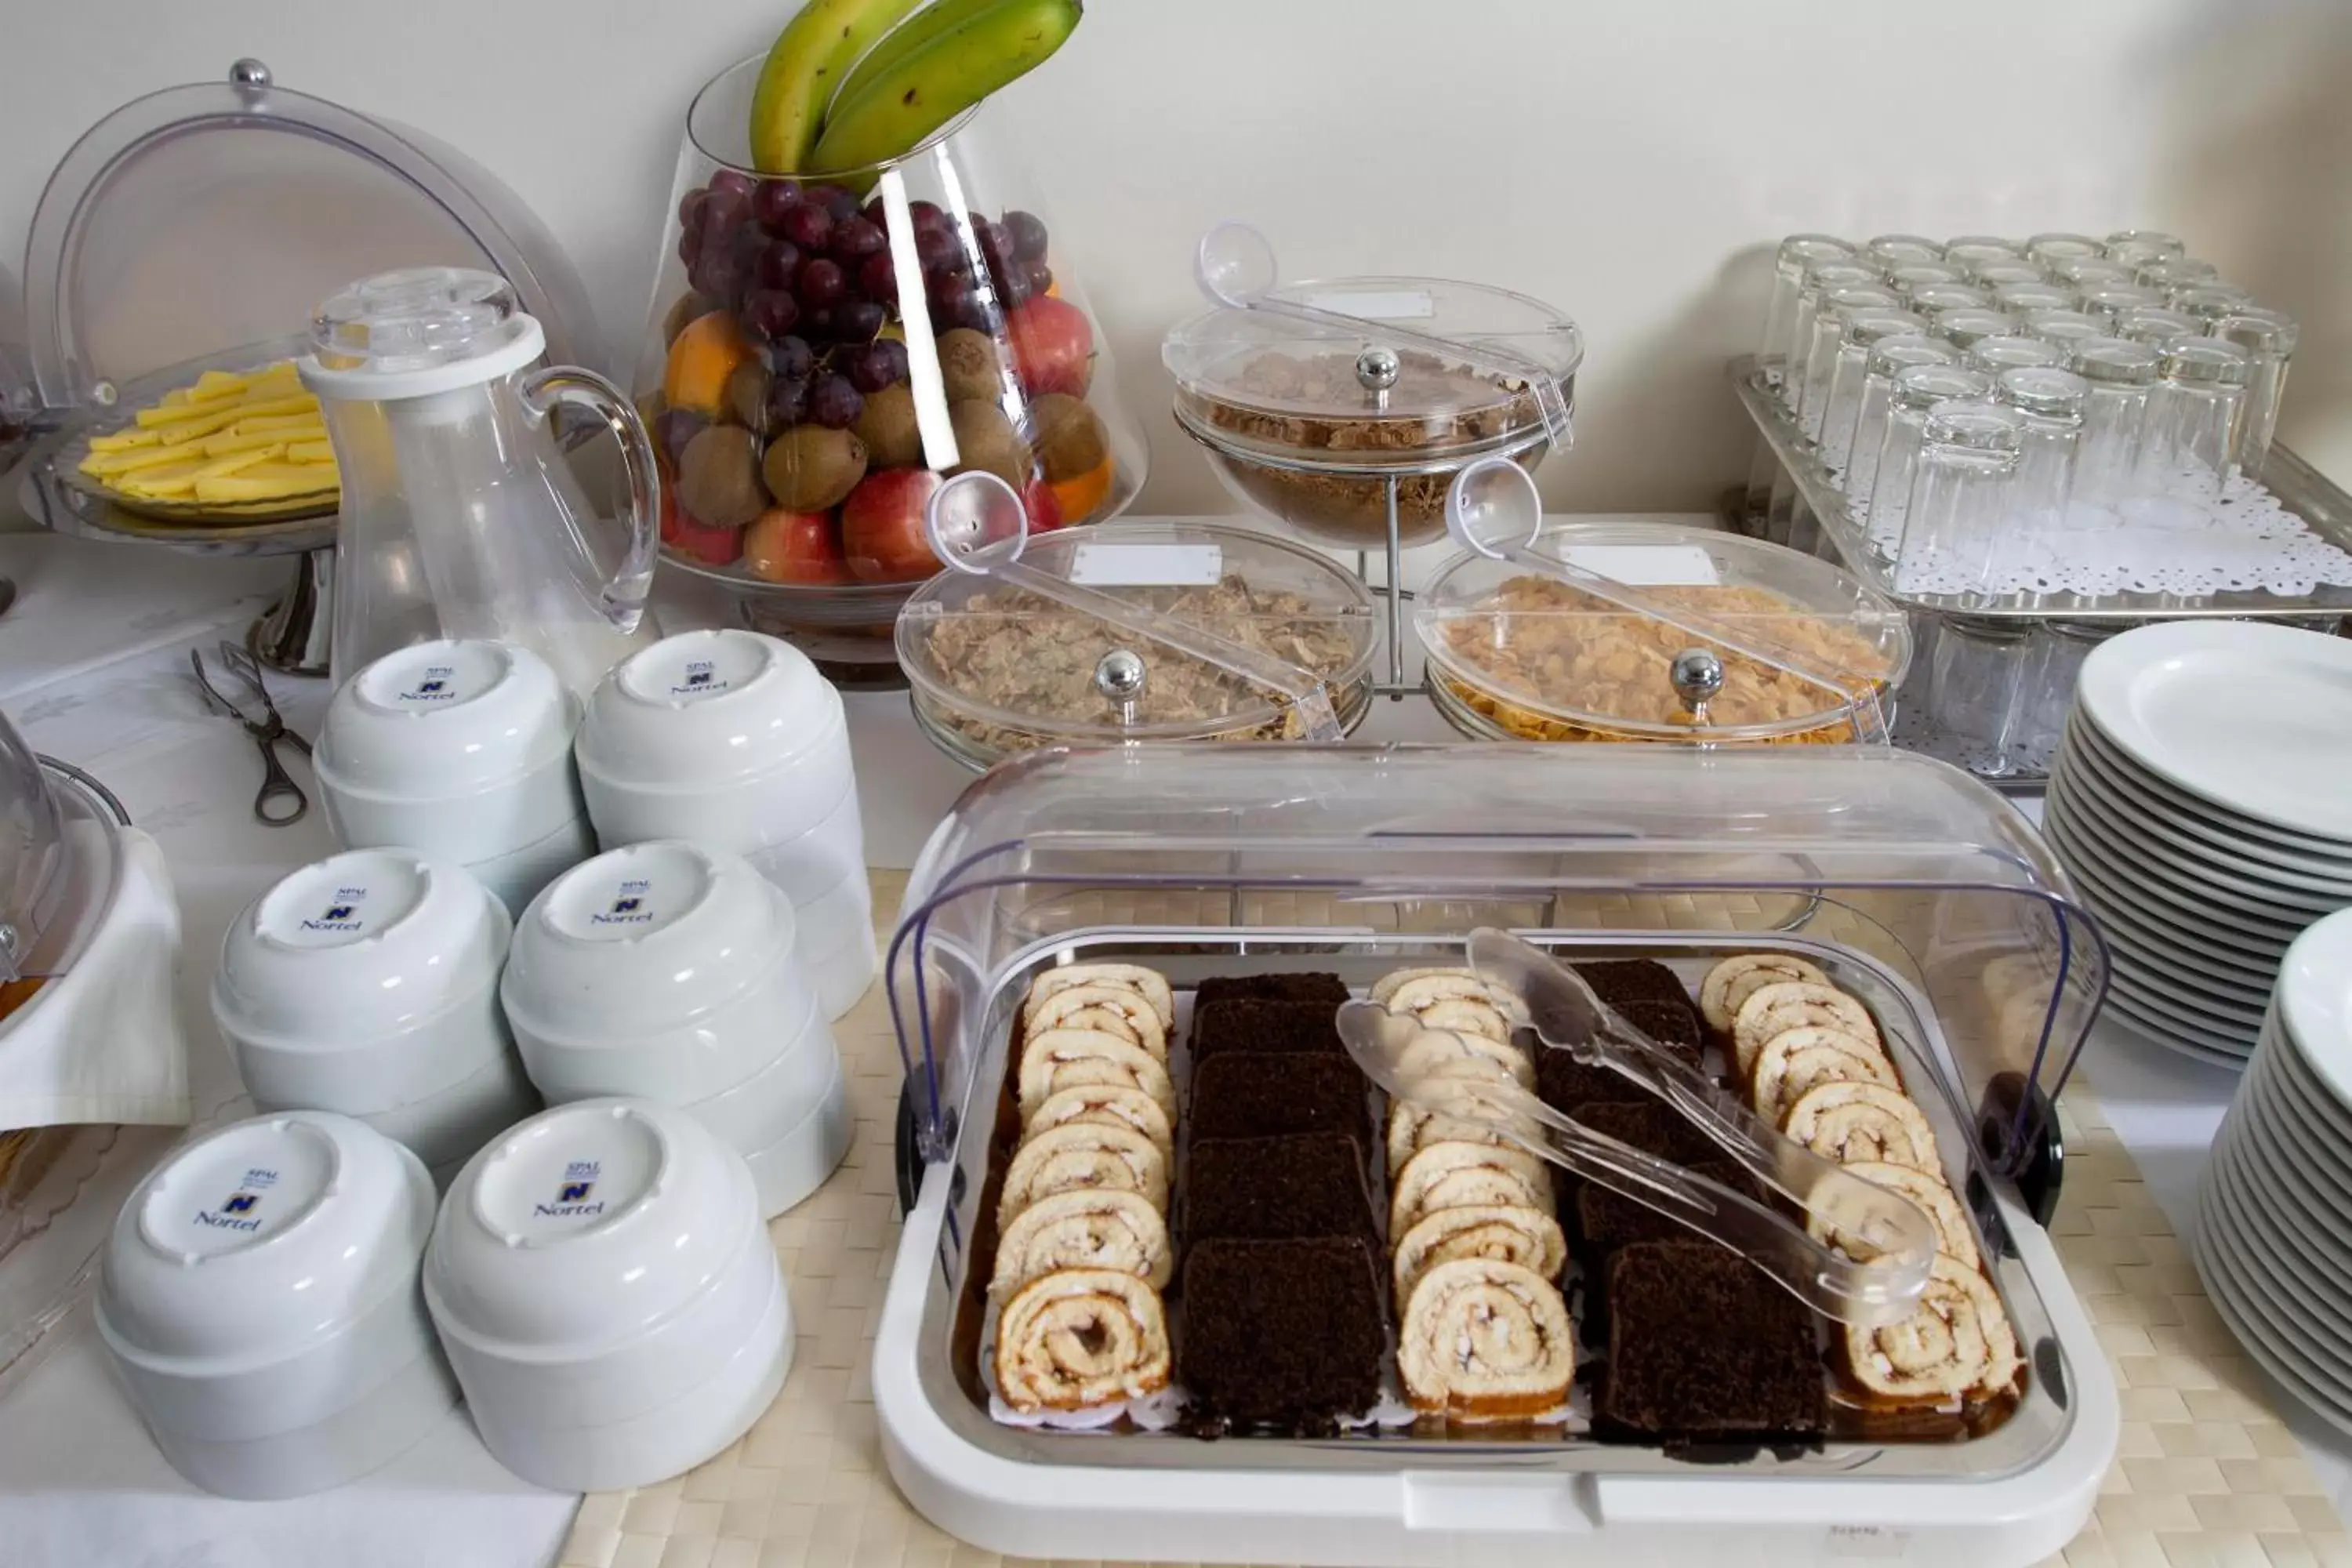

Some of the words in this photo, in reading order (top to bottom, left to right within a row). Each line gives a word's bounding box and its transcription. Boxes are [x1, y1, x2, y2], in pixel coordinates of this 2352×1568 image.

[590, 912, 653, 924] Nortel
[300, 920, 363, 931] Nortel
[533, 1201, 604, 1218] Nortel
[193, 1210, 261, 1231] Nortel
